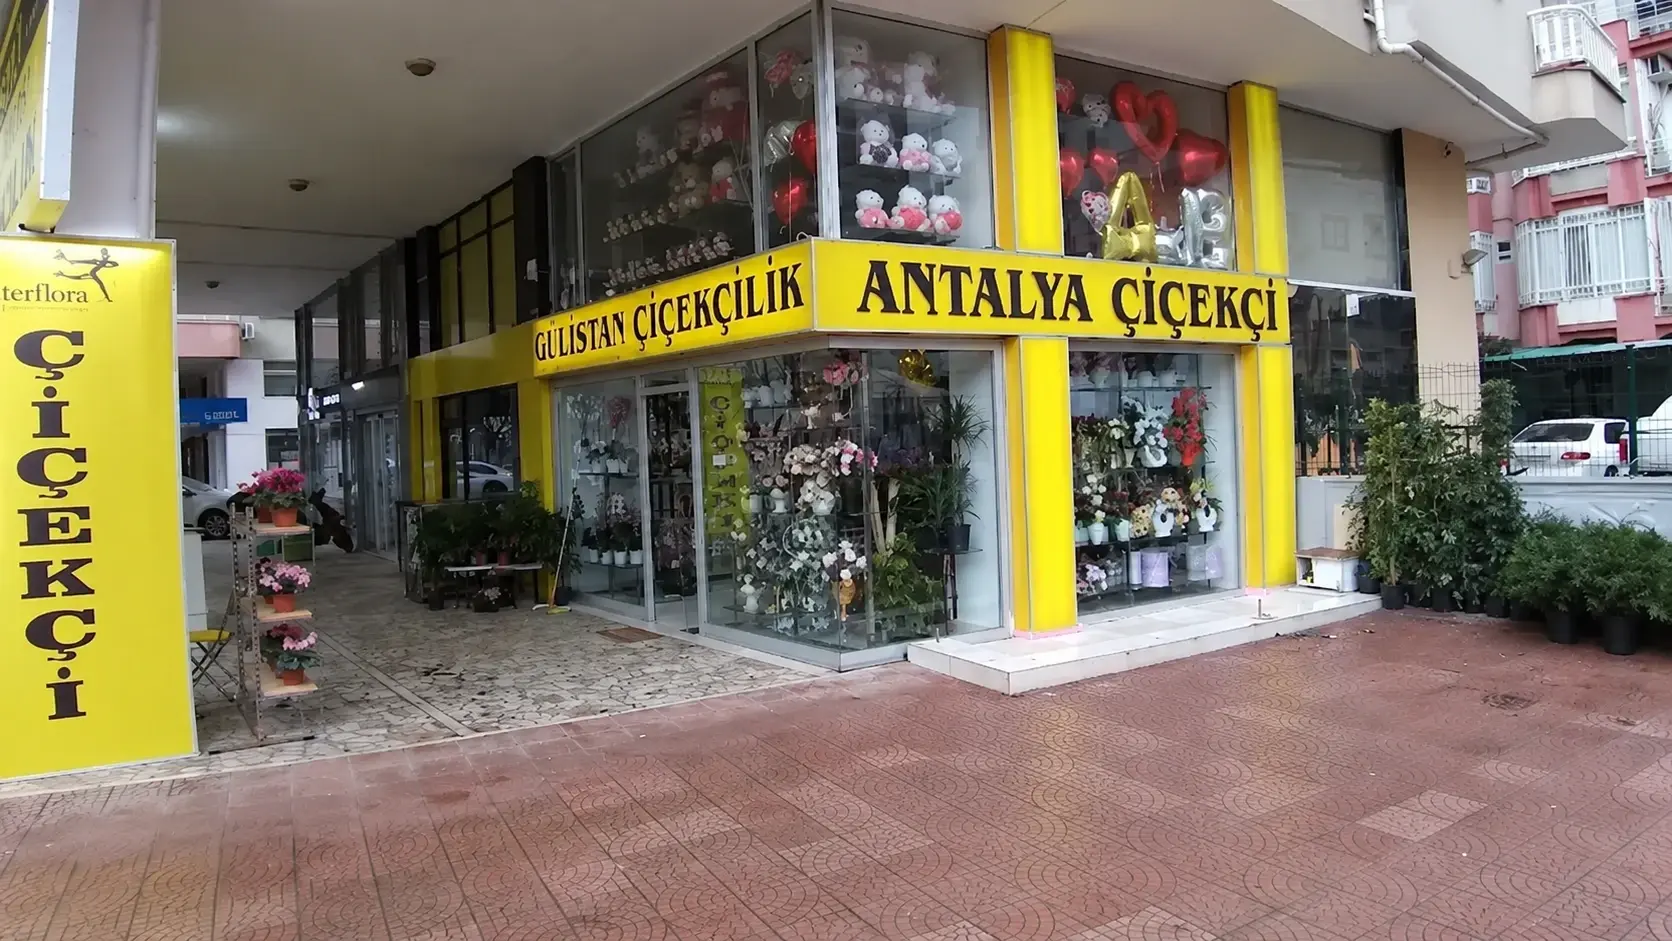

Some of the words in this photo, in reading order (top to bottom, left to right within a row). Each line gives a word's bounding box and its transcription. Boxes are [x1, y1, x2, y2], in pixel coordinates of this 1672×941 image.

[0, 283, 88, 303] terflora
[535, 311, 625, 361] GÜLİSTAN
[632, 255, 804, 351] ÇİÇEKÇİLİK
[857, 260, 1093, 322] ANTALYA
[1112, 266, 1278, 342] ÇİÇEKÇİ
[13, 329, 96, 721] ÇİÇEKÇİ
